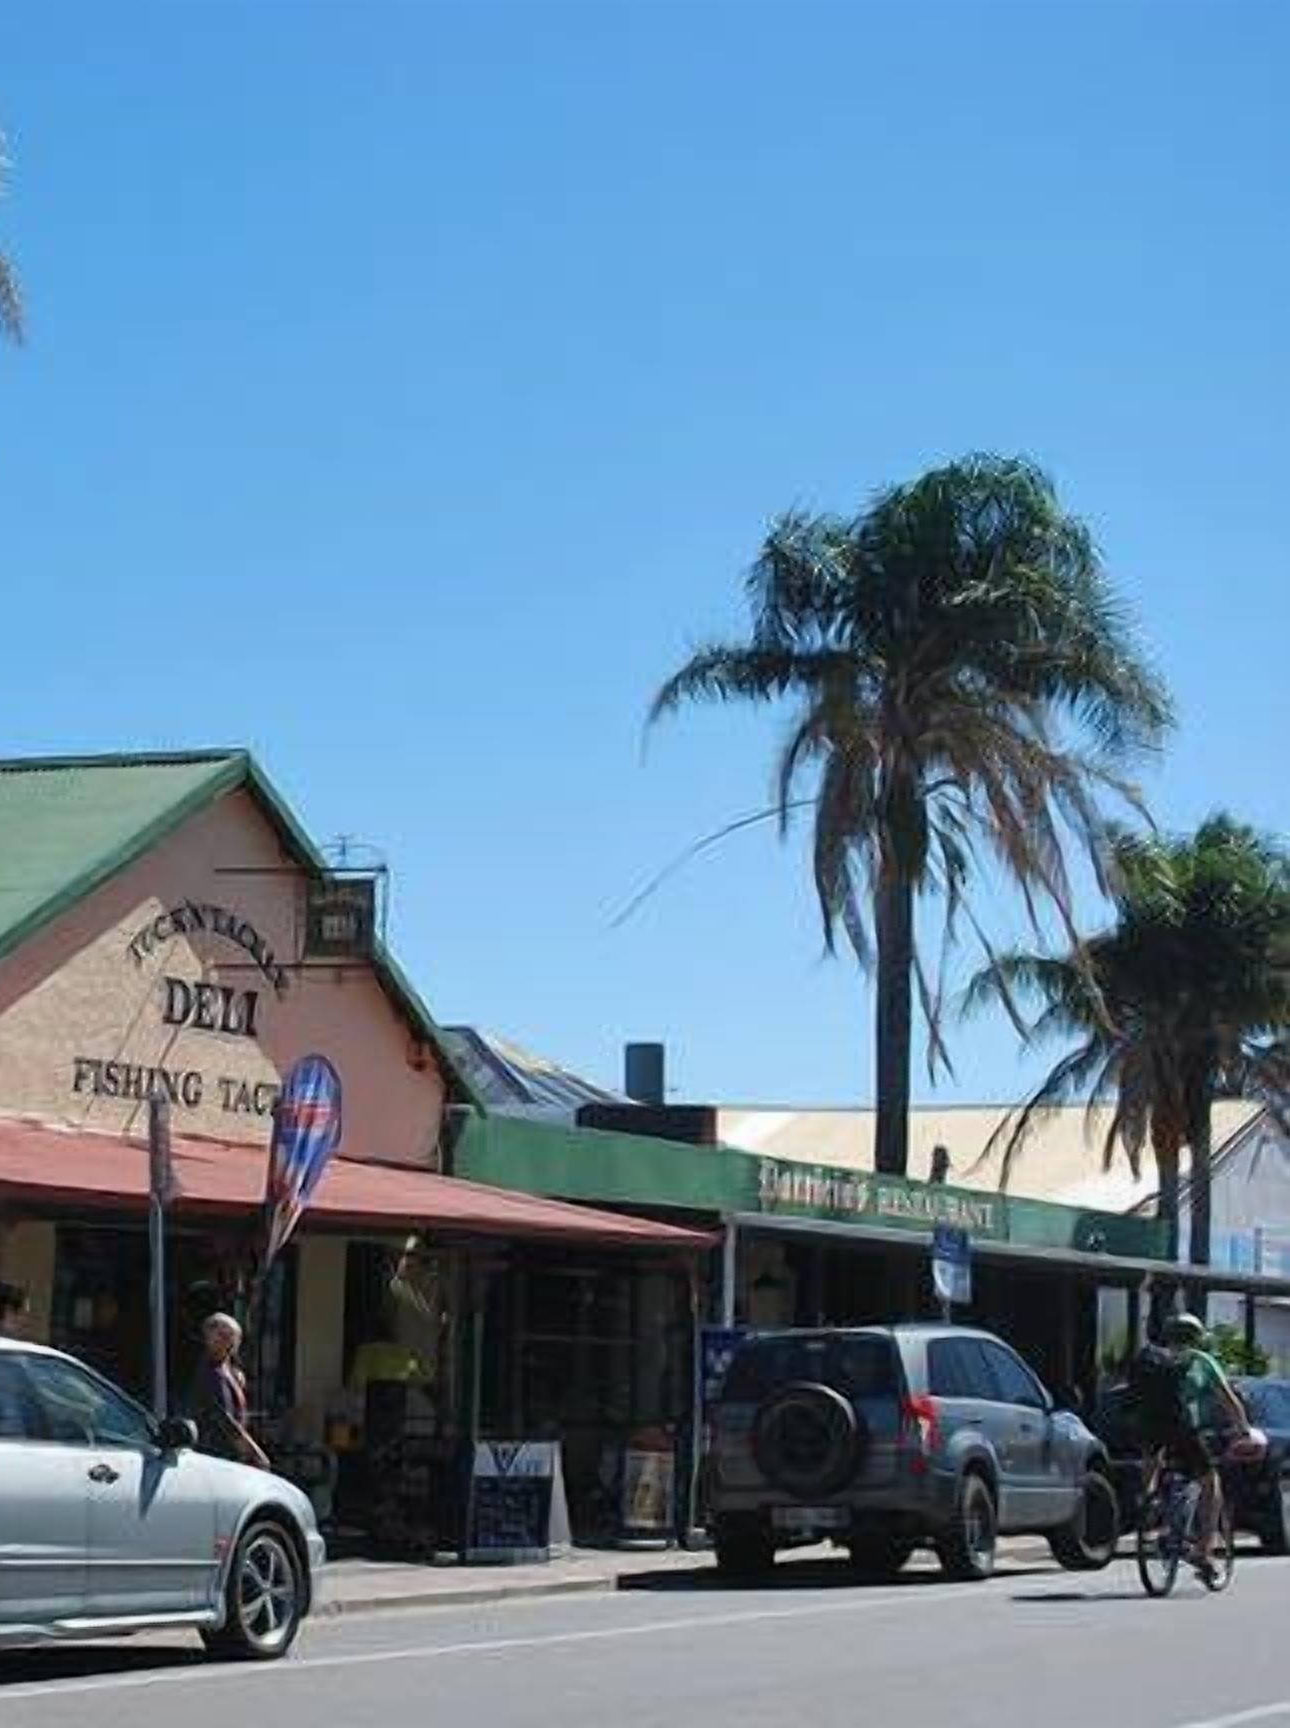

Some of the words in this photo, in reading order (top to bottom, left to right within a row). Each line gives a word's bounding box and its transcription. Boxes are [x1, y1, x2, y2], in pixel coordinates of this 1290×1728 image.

[162, 976, 259, 1036] DELI
[72, 1056, 203, 1108] FISHING
[218, 1075, 282, 1116] TAC
